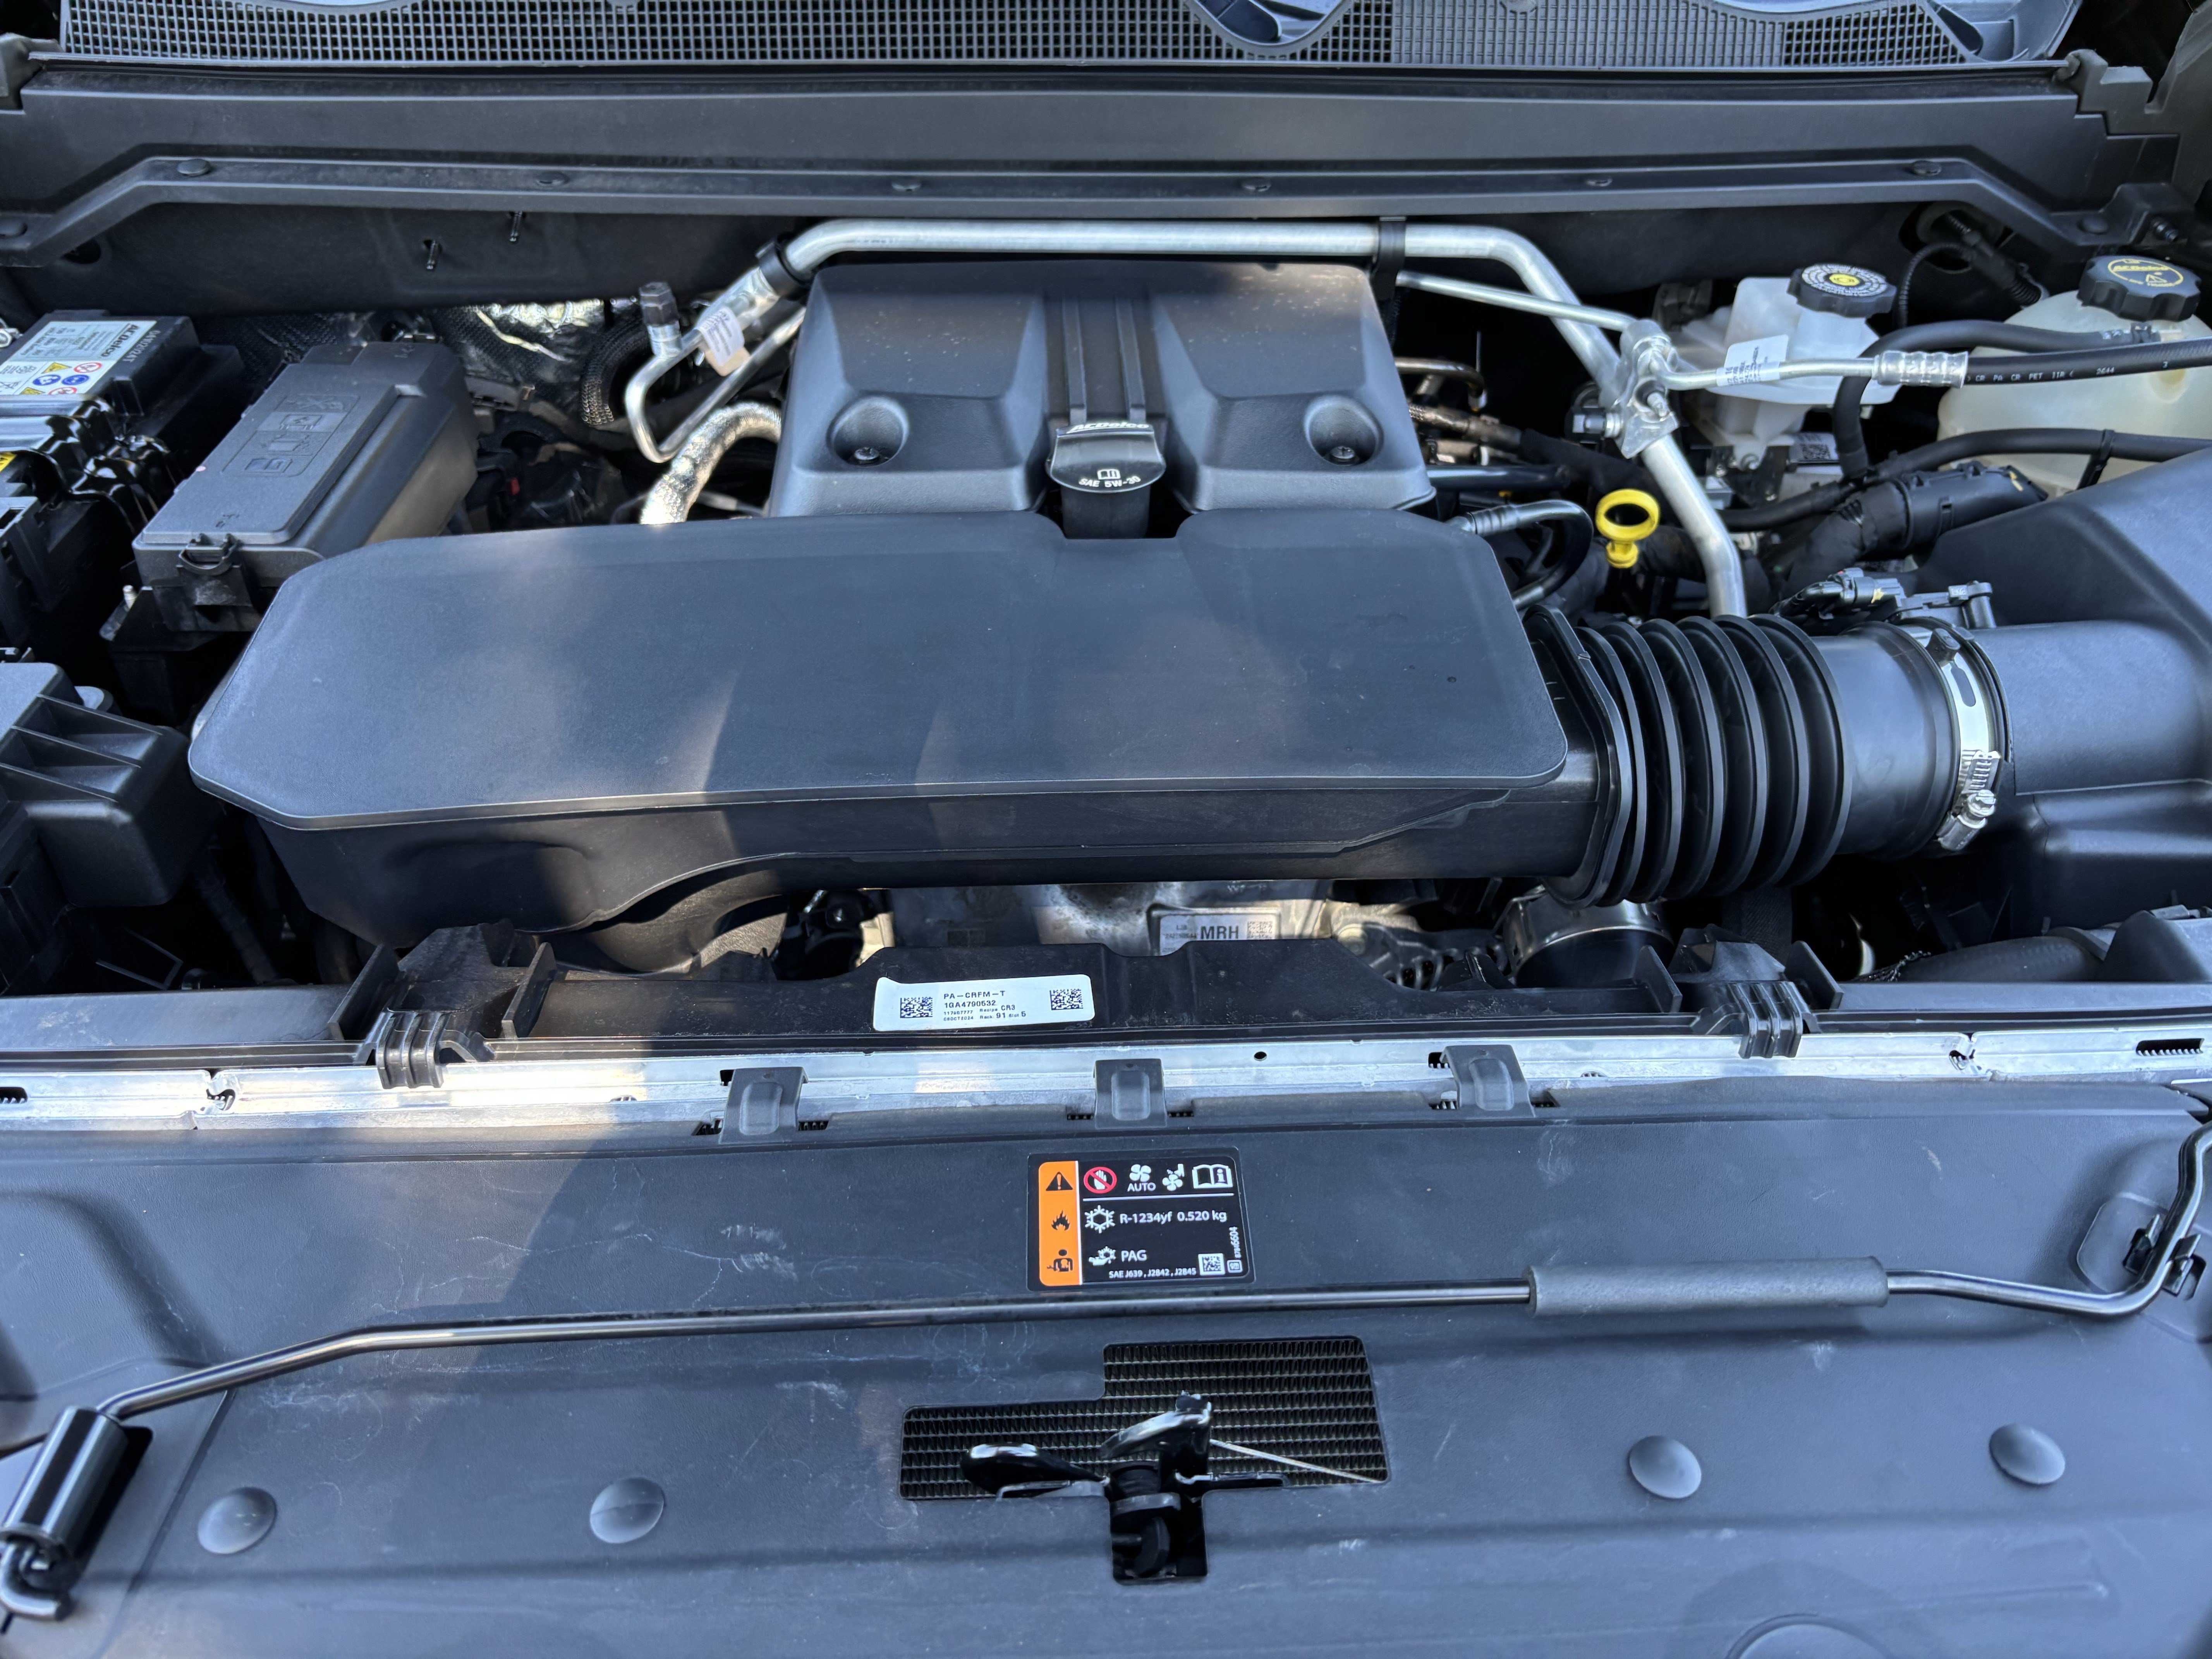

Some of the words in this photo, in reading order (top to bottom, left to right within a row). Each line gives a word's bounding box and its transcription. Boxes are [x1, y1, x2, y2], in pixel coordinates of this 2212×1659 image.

[1067, 422, 1149, 433] ACDelco
[1079, 478, 1100, 487] SAE
[1104, 476, 1141, 488] 5W-30
[1200, 926, 1239, 939] MRH
[1127, 1182, 1156, 1192] AUTO
[1120, 1211, 1173, 1224] R-1234yf
[1177, 1211, 1210, 1221] 0.520
[1212, 1210, 1227, 1223] kg
[1121, 1249, 1147, 1262] PAG
[1175, 1267, 1197, 1276] J2845
